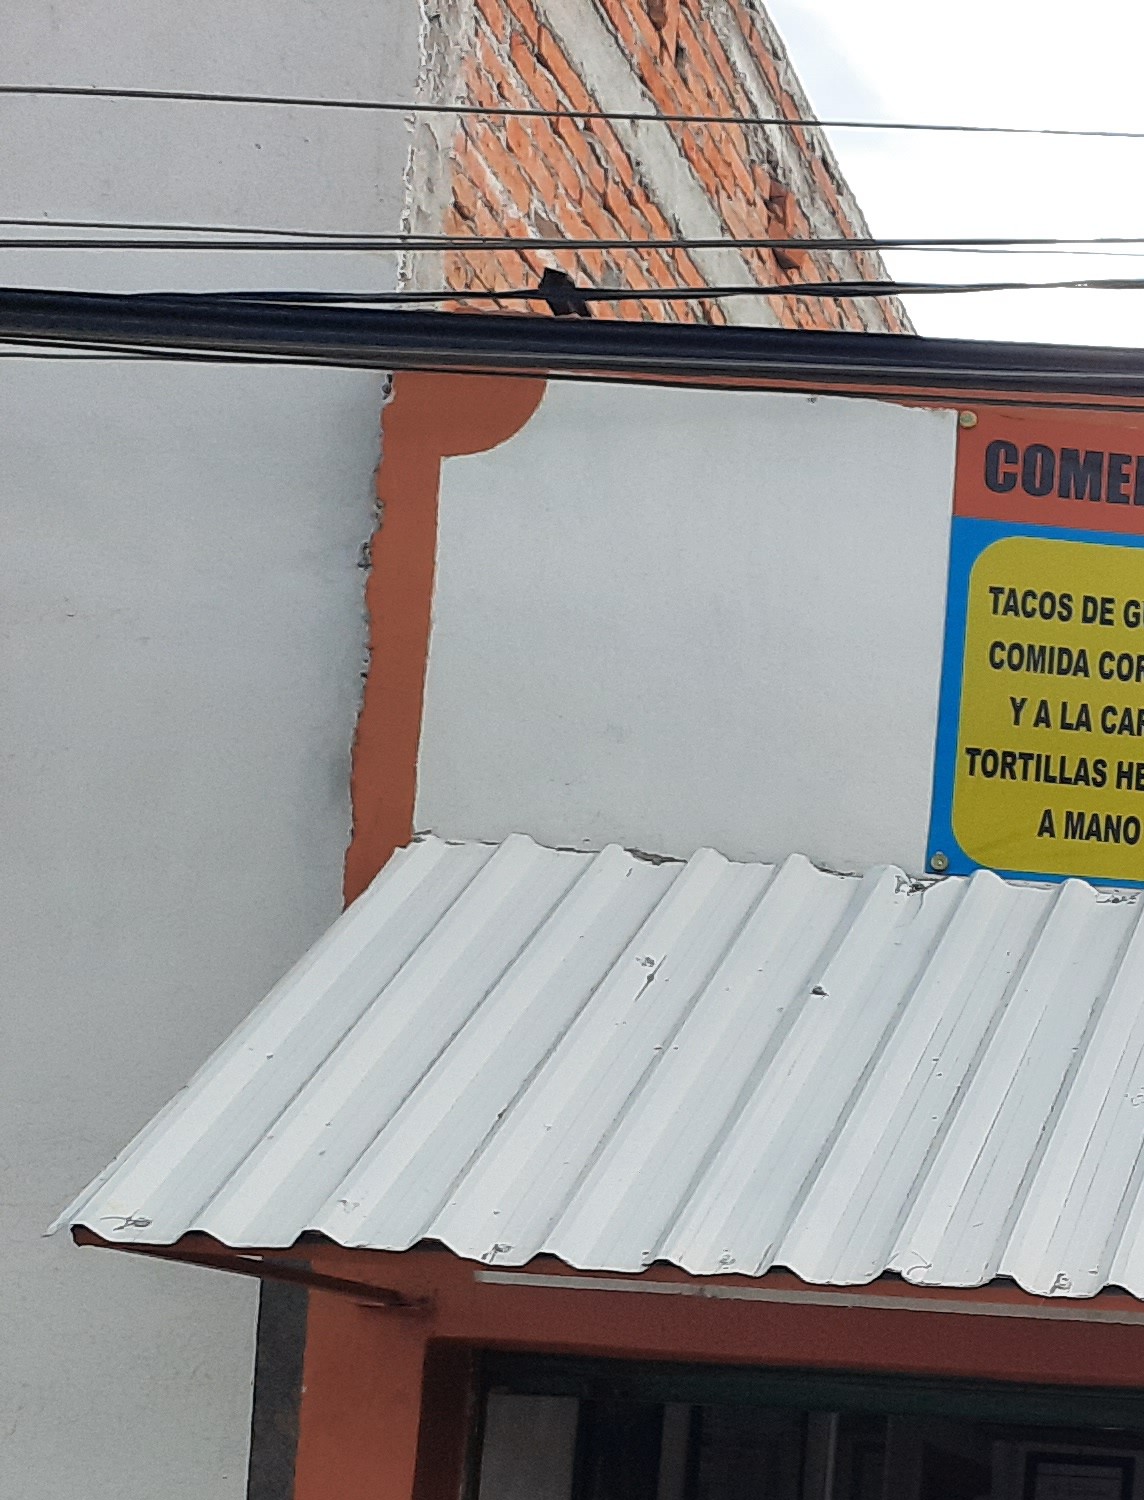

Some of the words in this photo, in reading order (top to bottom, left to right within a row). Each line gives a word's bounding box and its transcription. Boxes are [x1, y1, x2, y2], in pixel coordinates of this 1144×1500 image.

[988, 586, 1073, 622] TACOS
[1081, 595, 1116, 627] DE
[989, 640, 1090, 678] COMIDA
[1009, 696, 1028, 726] Y
[1032, 699, 1052, 729] A
[1060, 701, 1092, 733] LA
[965, 747, 1108, 788] TORTILLAS
[1036, 808, 1056, 839] A
[1063, 810, 1141, 846] MANO
